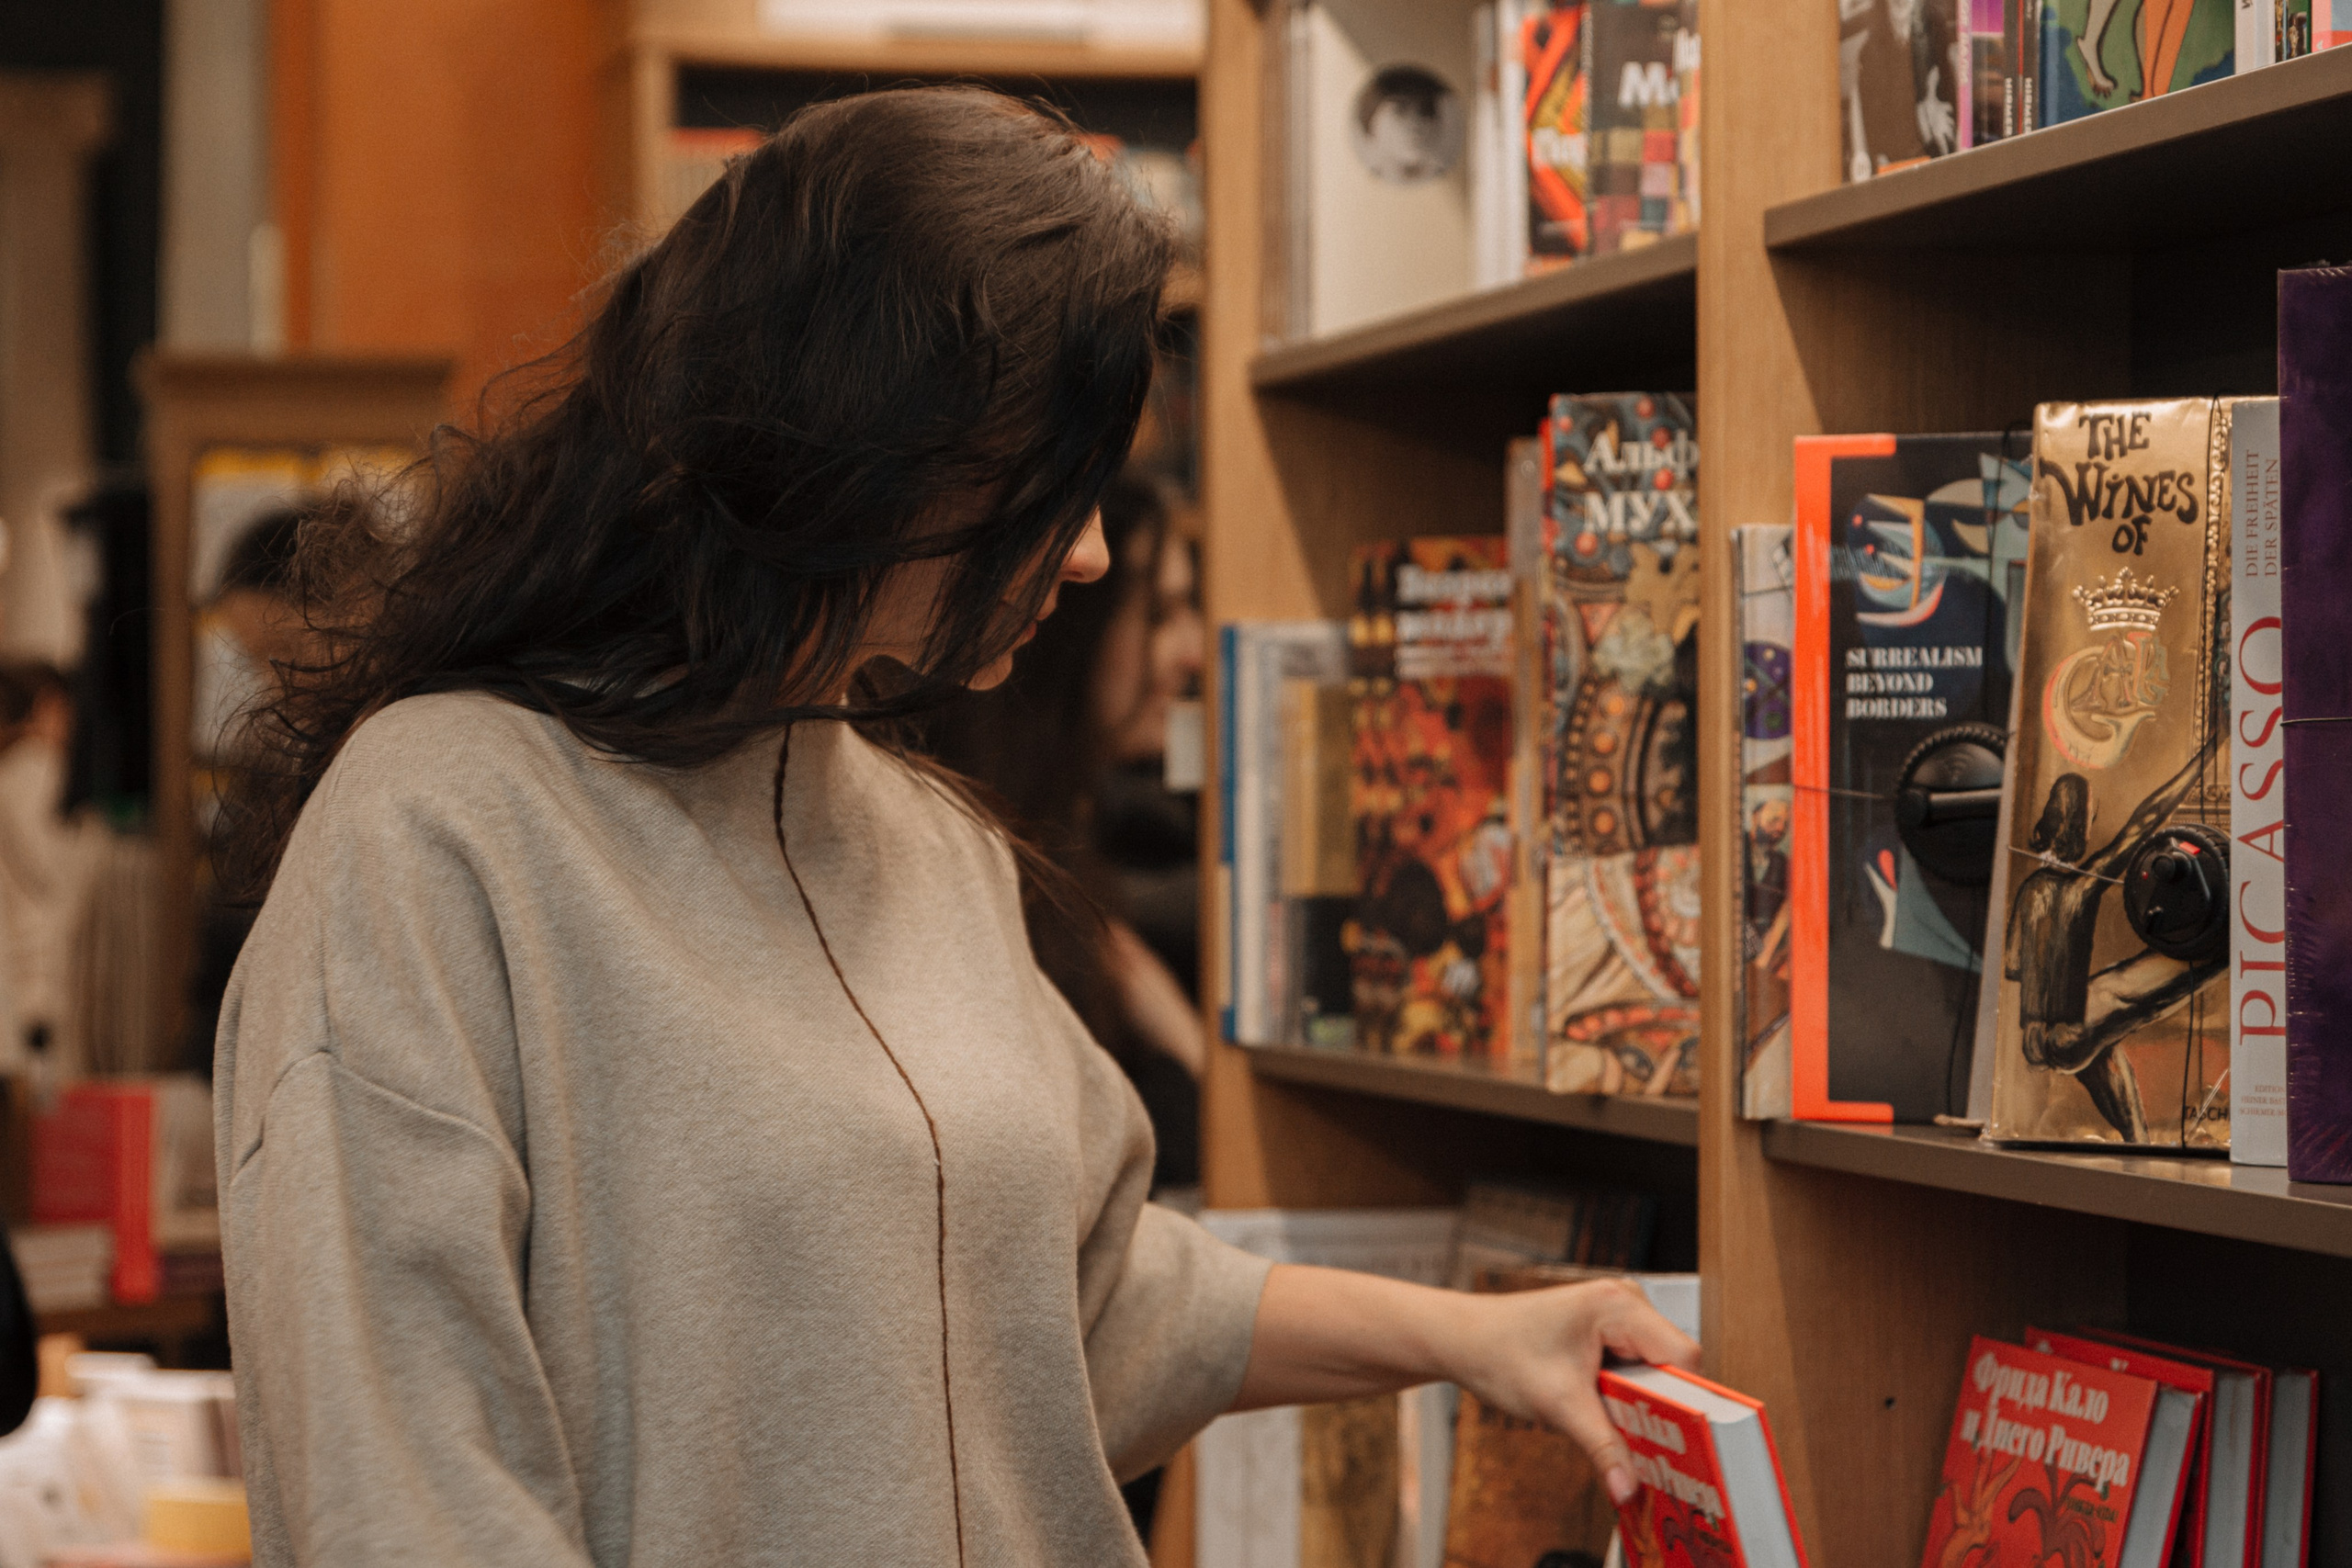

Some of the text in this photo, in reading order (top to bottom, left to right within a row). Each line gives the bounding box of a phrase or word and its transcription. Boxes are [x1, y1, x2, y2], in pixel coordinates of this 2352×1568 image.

[2078, 412, 2152, 460] THE
[2112, 514, 2153, 556] OF
[2245, 449, 2259, 578] DIE FREIHEIT
[2264, 458, 2278, 578] DER SPÄTEN
[1846, 646, 1983, 669] SURREALISM
[1846, 671, 1934, 694] BEYOND
[1846, 696, 1948, 719] BORDERS
[2237, 615, 2287, 1045] PICASSO
[1973, 1350, 2109, 1425] Фрида Кало
[1977, 1407, 2045, 1462] Диего
[2043, 1424, 2131, 1493] Ривера
